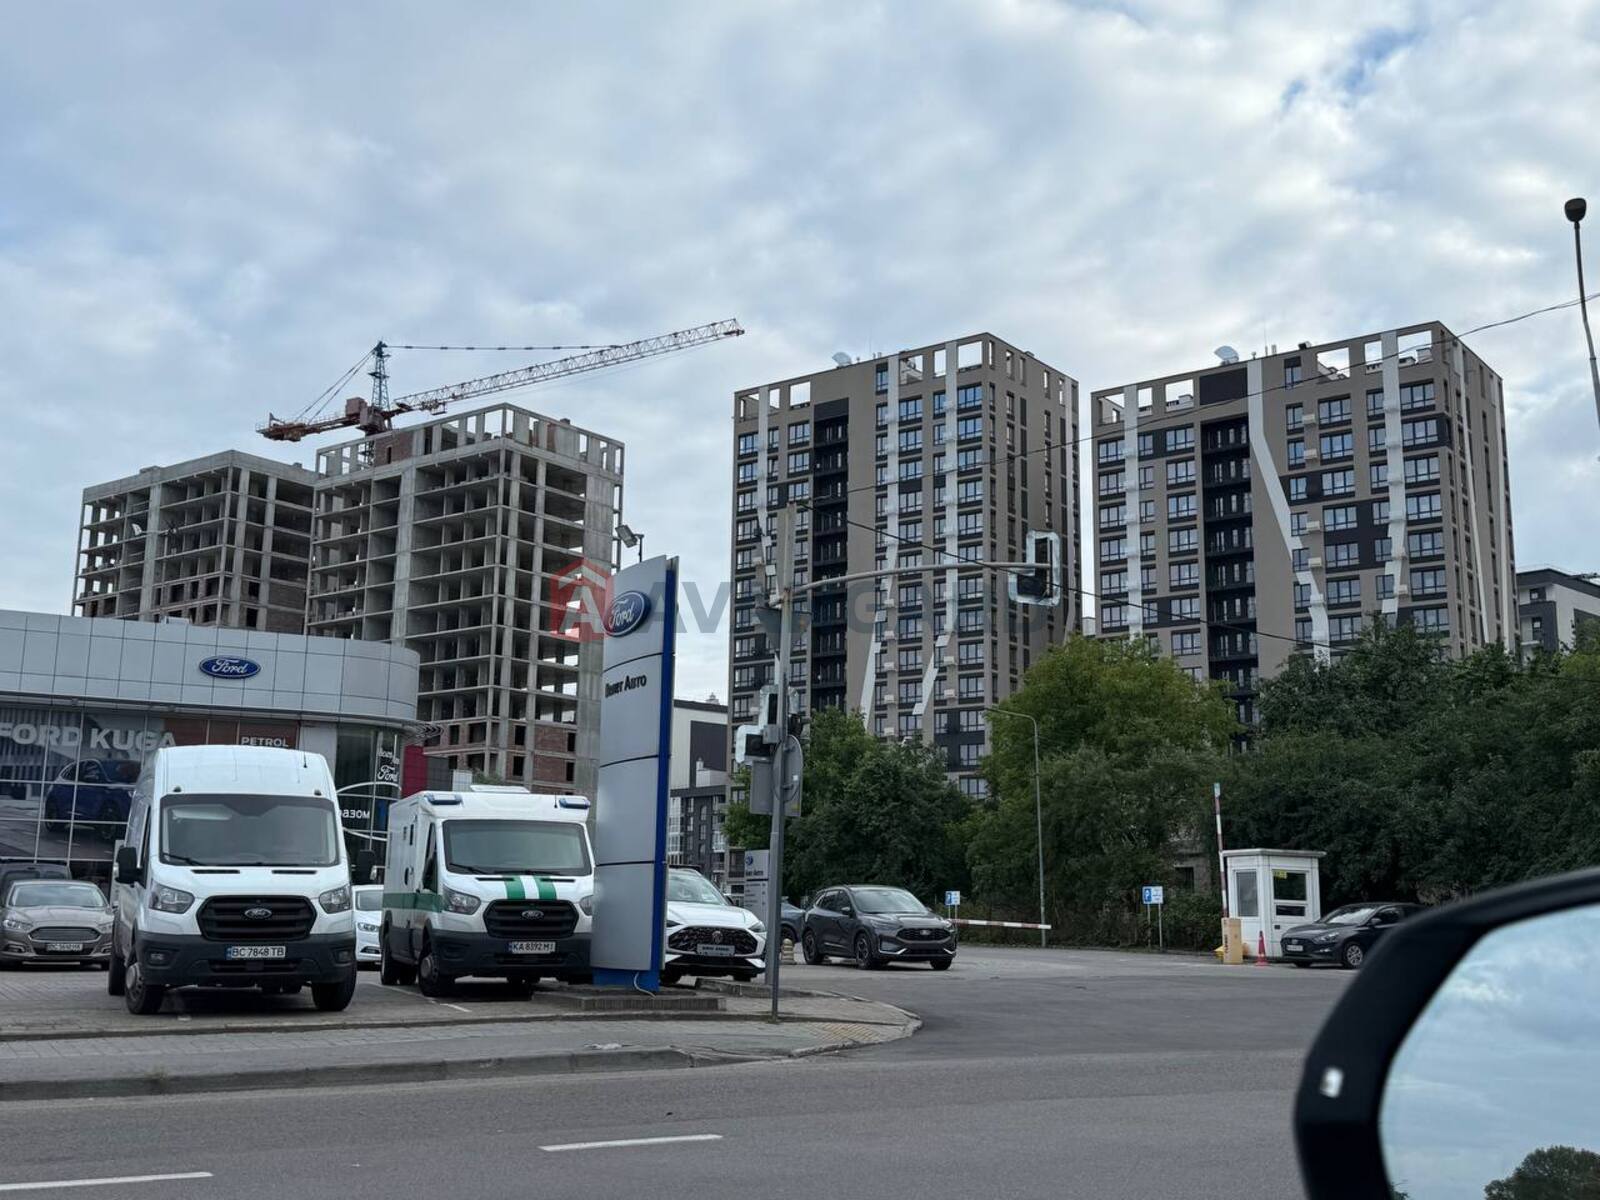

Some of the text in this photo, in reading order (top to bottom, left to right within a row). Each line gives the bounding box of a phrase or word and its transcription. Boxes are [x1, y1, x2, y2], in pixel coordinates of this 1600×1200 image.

[90, 727, 176, 750] KUGA
[240, 736, 289, 748] PETROL
[340, 809, 370, 819] азом
